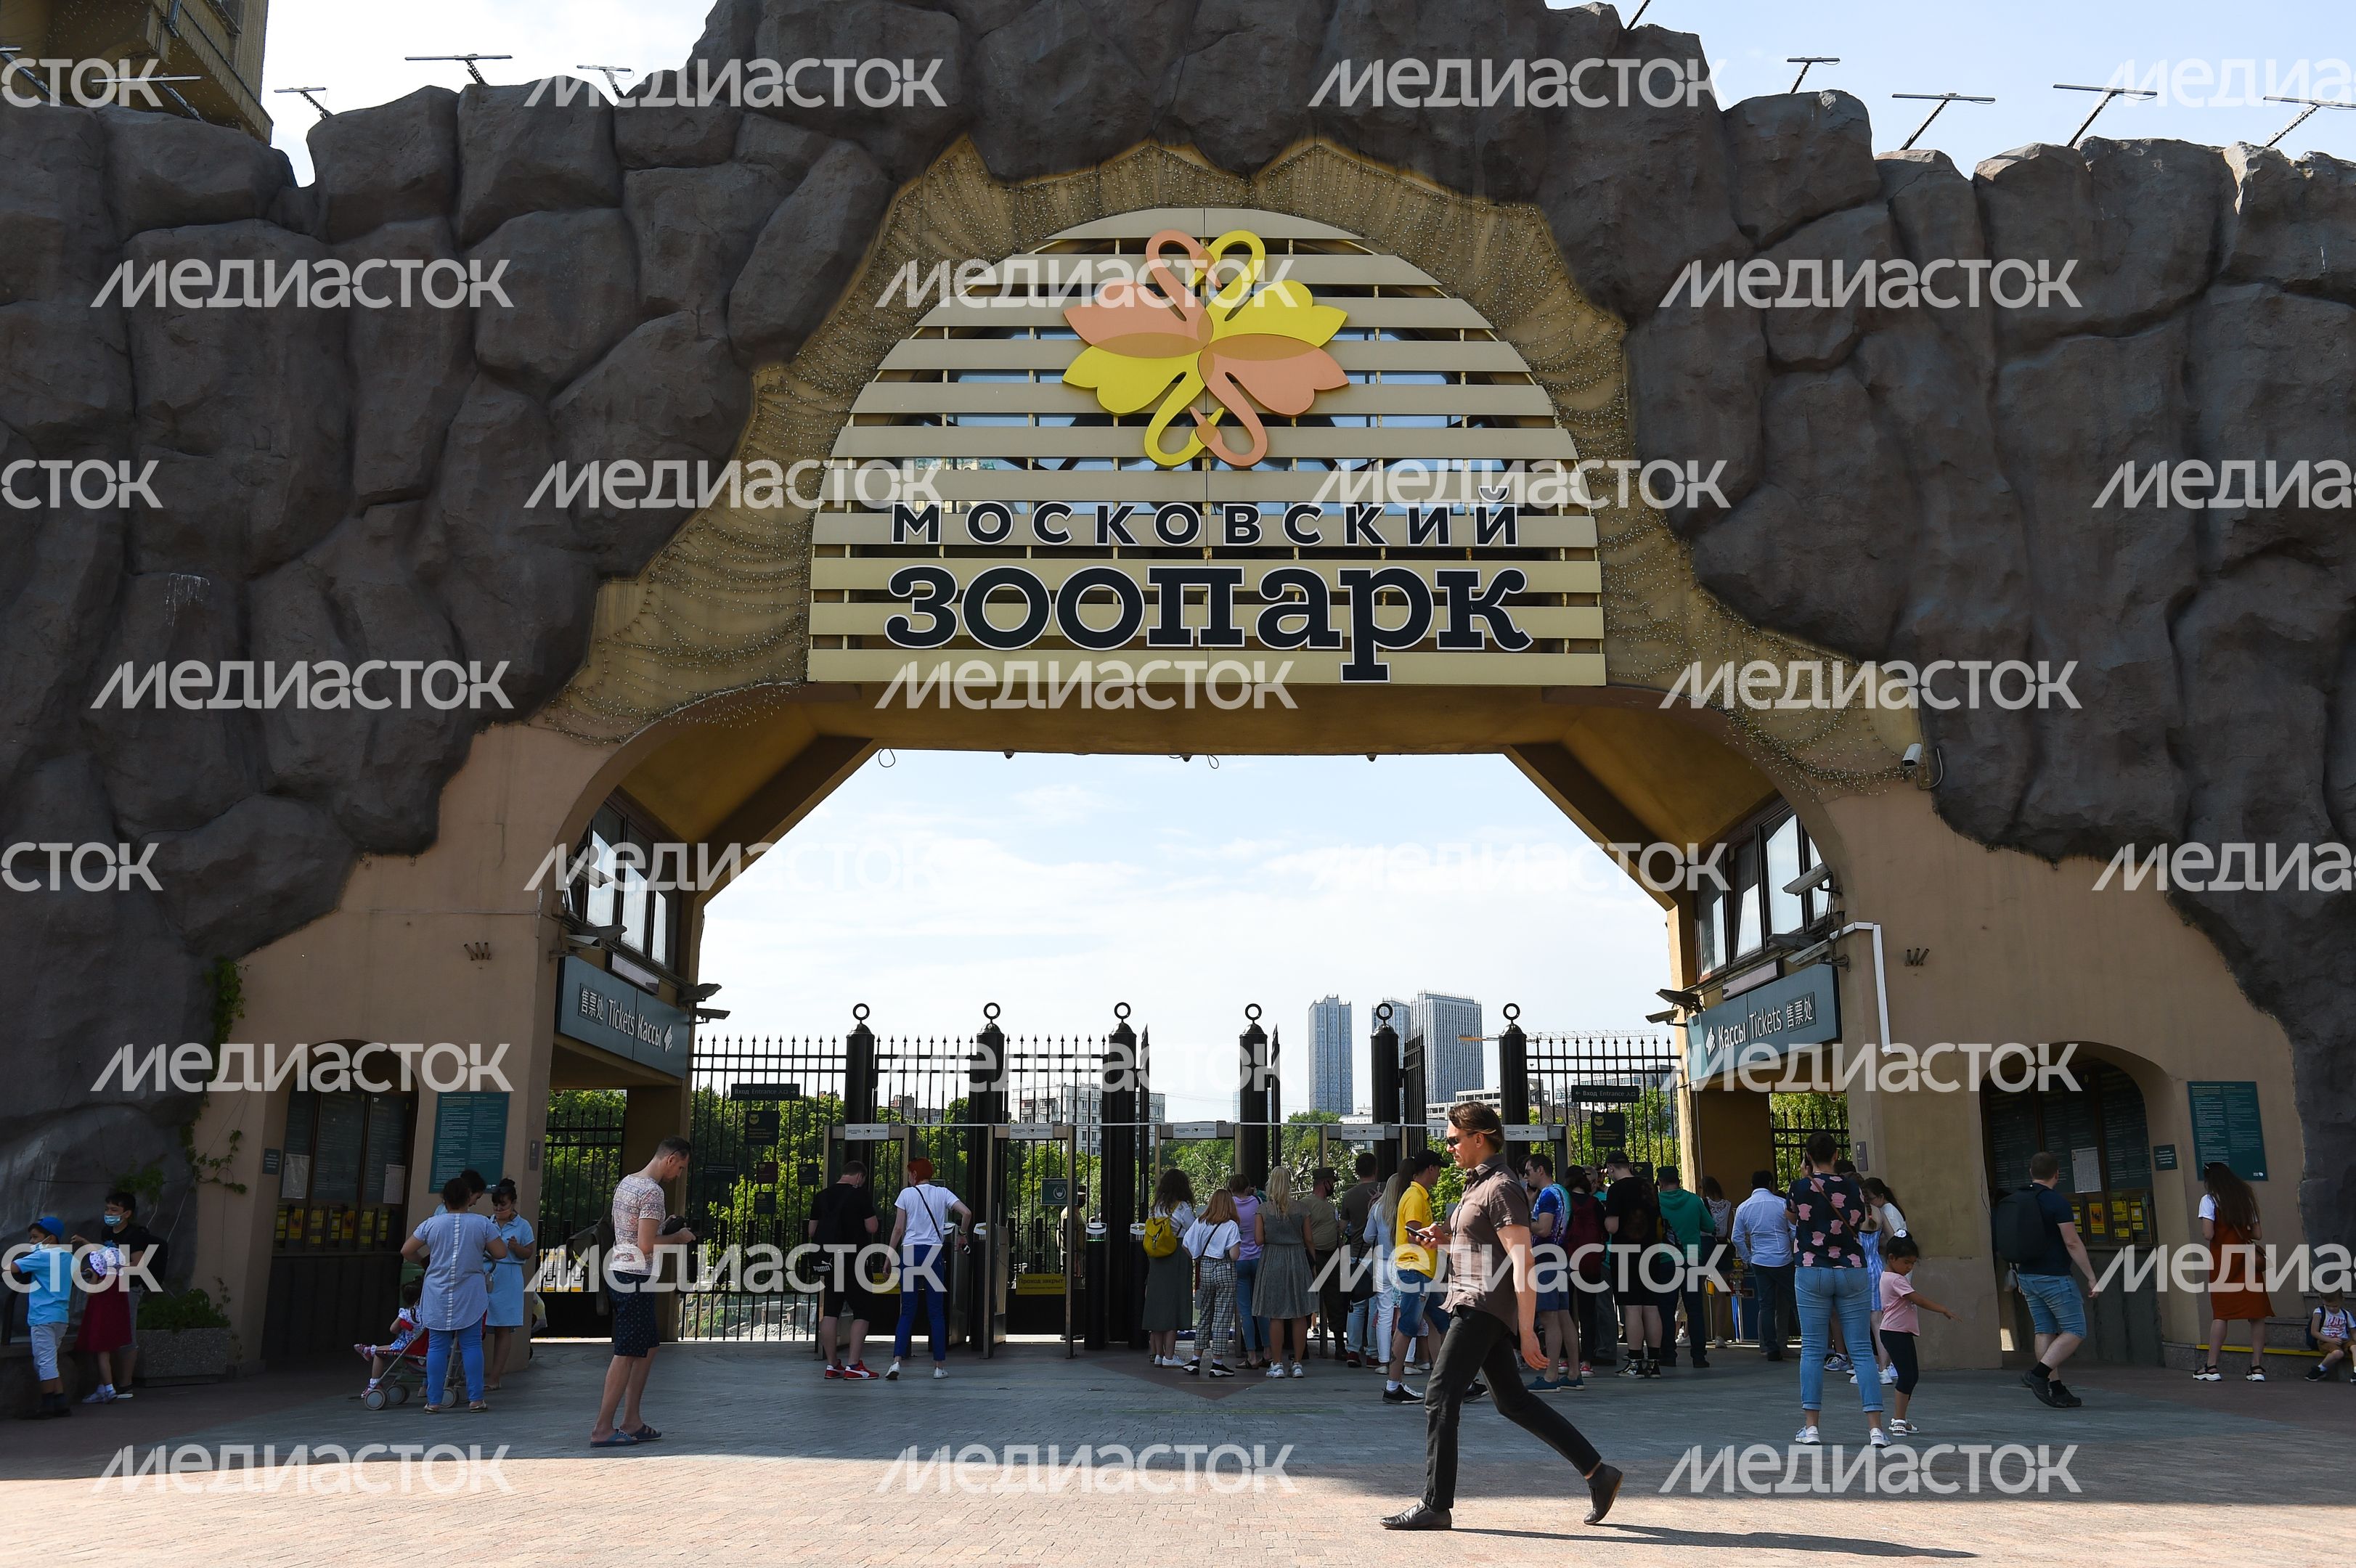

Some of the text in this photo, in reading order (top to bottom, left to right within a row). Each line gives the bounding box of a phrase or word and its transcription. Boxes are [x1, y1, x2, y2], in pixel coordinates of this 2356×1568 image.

[582, 988, 662, 1048] 售票处 Tickets Кассы
[1718, 996, 1813, 1050] Кассы Tickets 售票处
